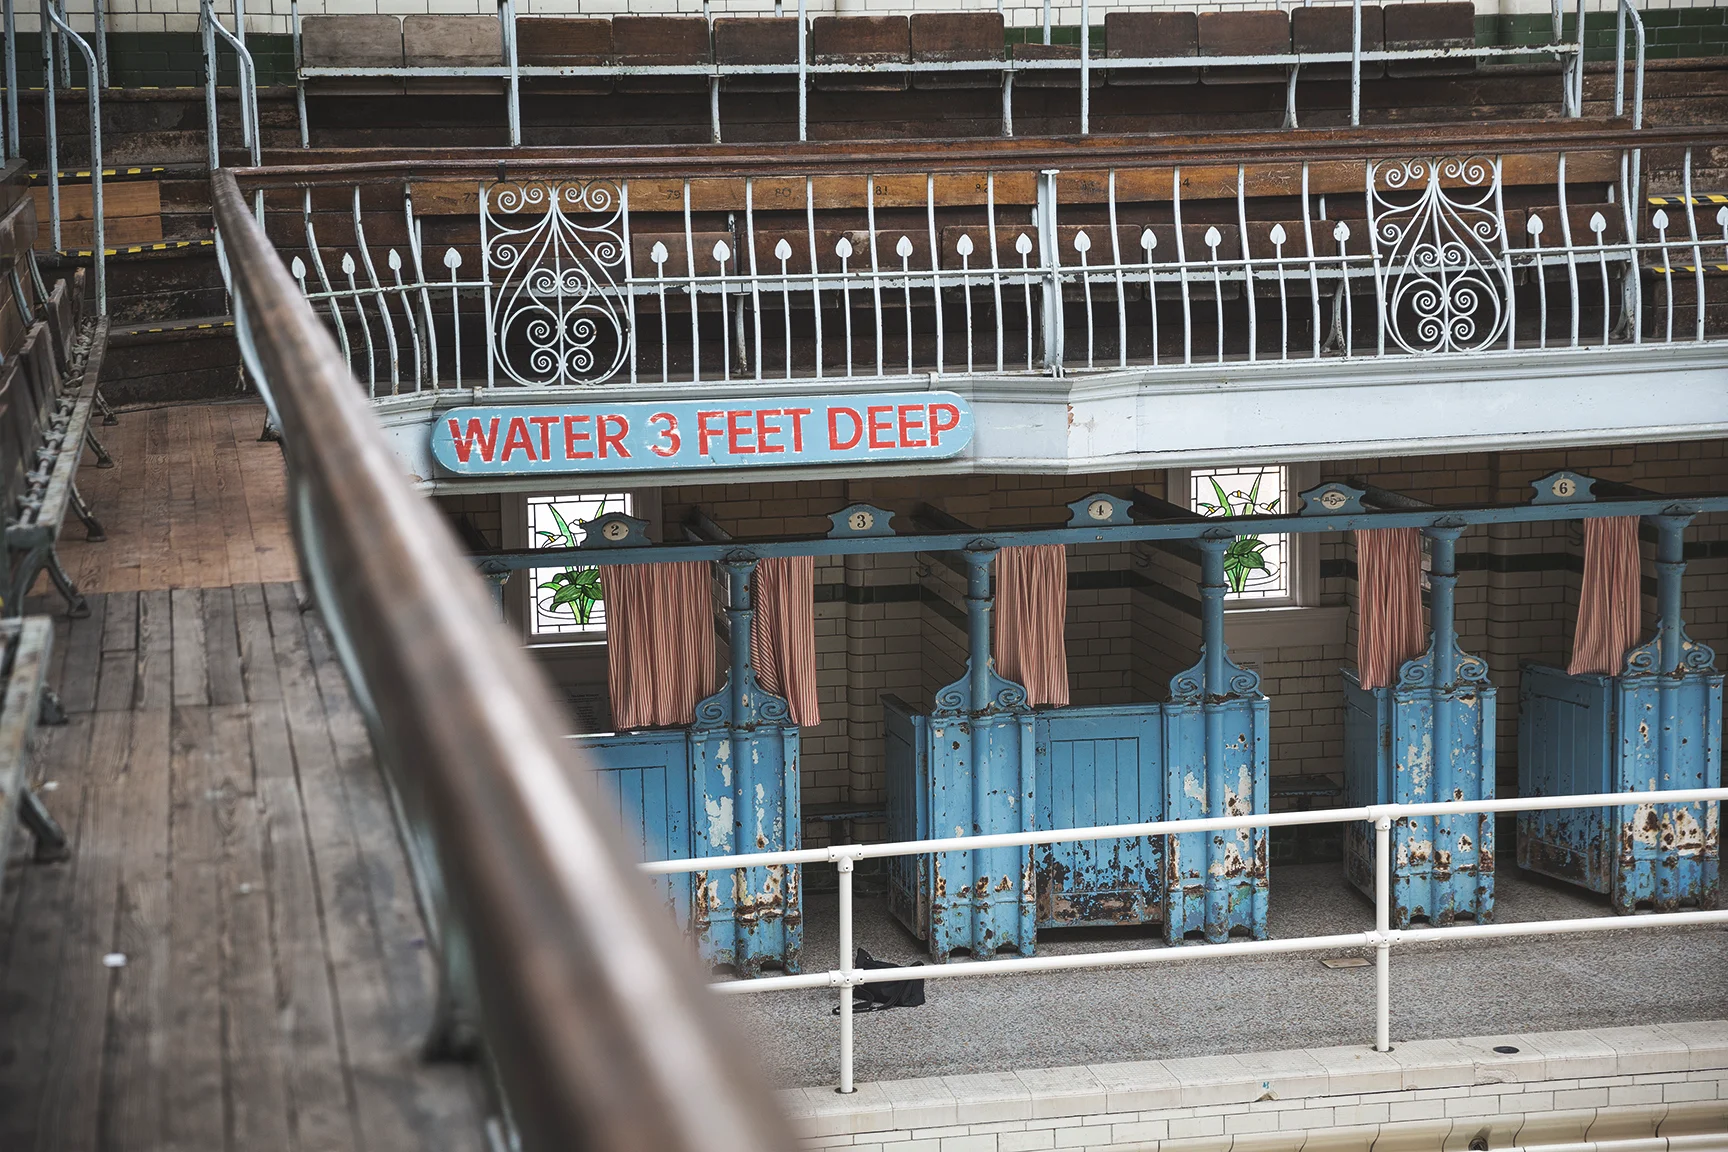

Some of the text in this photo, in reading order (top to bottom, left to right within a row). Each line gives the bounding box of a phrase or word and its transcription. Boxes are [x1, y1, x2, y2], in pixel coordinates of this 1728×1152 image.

[667, 189, 681, 200] 79
[876, 185, 888, 196] 81
[447, 403, 961, 464] WATER 3 FEET DEEP
[1559, 481, 1568, 495] 6
[1096, 504, 1105, 516] 4
[856, 514, 866, 529] 3
[611, 523, 620, 537] 2
